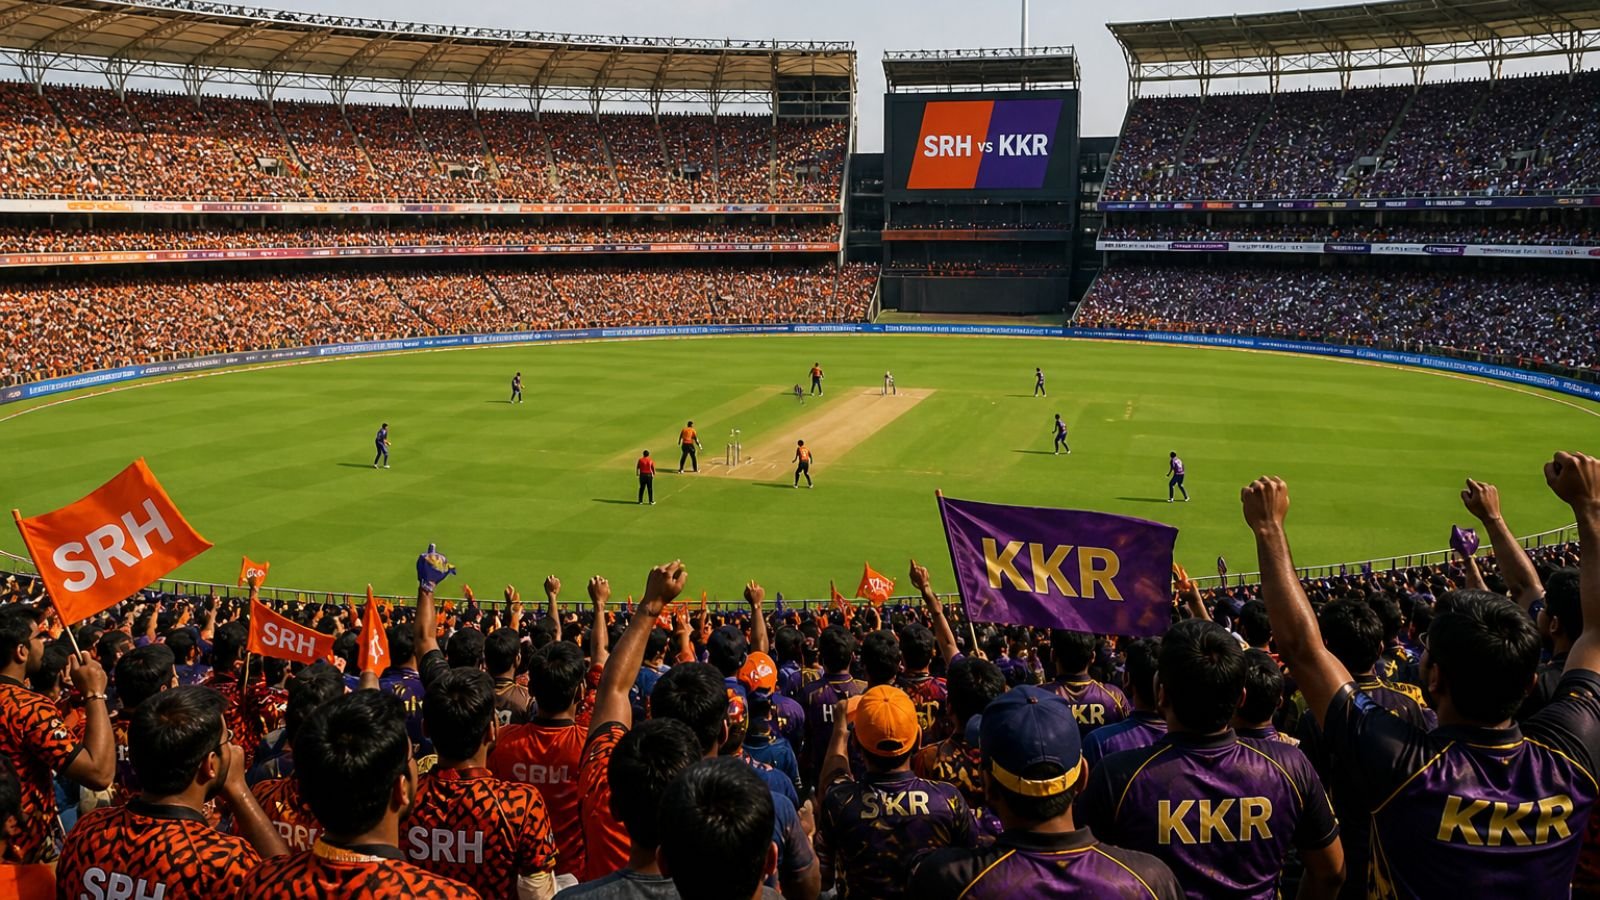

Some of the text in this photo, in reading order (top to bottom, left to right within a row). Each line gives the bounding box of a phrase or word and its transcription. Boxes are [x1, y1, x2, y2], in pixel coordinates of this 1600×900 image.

[923, 135, 972, 157] SRH
[998, 134, 1048, 156] KKR
[52, 498, 174, 593] SRH
[981, 537, 1124, 602] KKR
[261, 622, 316, 658] SRH
[1068, 703, 1105, 725] KR
[1157, 796, 1274, 845] KKR
[1436, 794, 1574, 847] KKR
[407, 825, 484, 865] SRH
[81, 866, 167, 900] SRH
